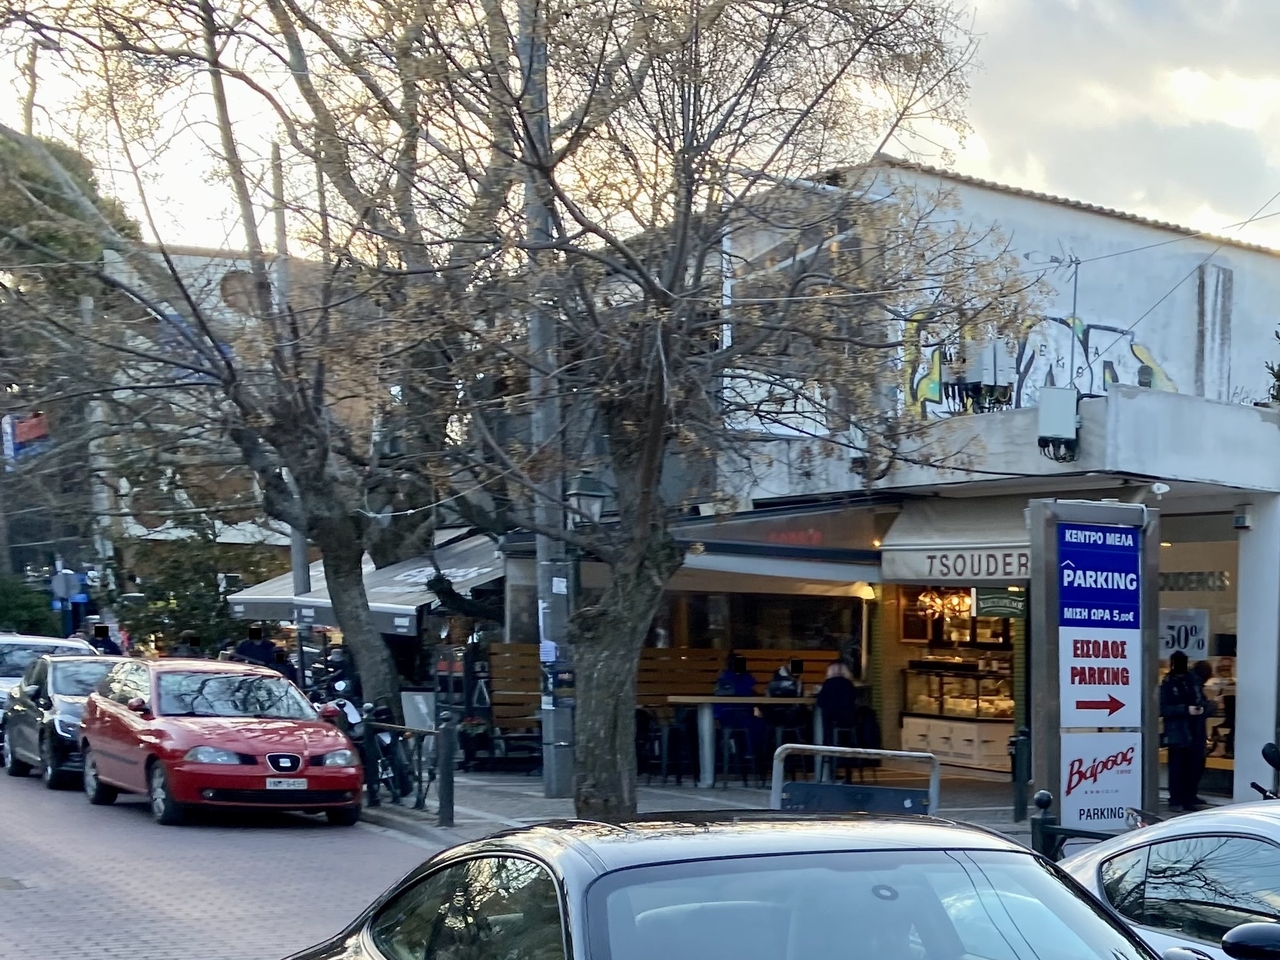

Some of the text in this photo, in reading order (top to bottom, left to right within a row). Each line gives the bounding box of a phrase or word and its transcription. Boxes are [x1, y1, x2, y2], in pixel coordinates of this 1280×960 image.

[1065, 529, 1134, 547] ΚΕΝΤΡΟ ΜΕΛΑ
[926, 552, 1030, 577] TSOUDER
[1063, 569, 1138, 591] PARKING
[1063, 607, 1088, 620] ΜΙΣΗ
[1090, 608, 1111, 621] ΩΡΑ
[1158, 624, 1205, 650] -50%
[1072, 639, 1128, 660] ΕΙΣΟΔΟΣ
[1070, 666, 1130, 686] PARKING
[1079, 806, 1125, 821] PARKING
